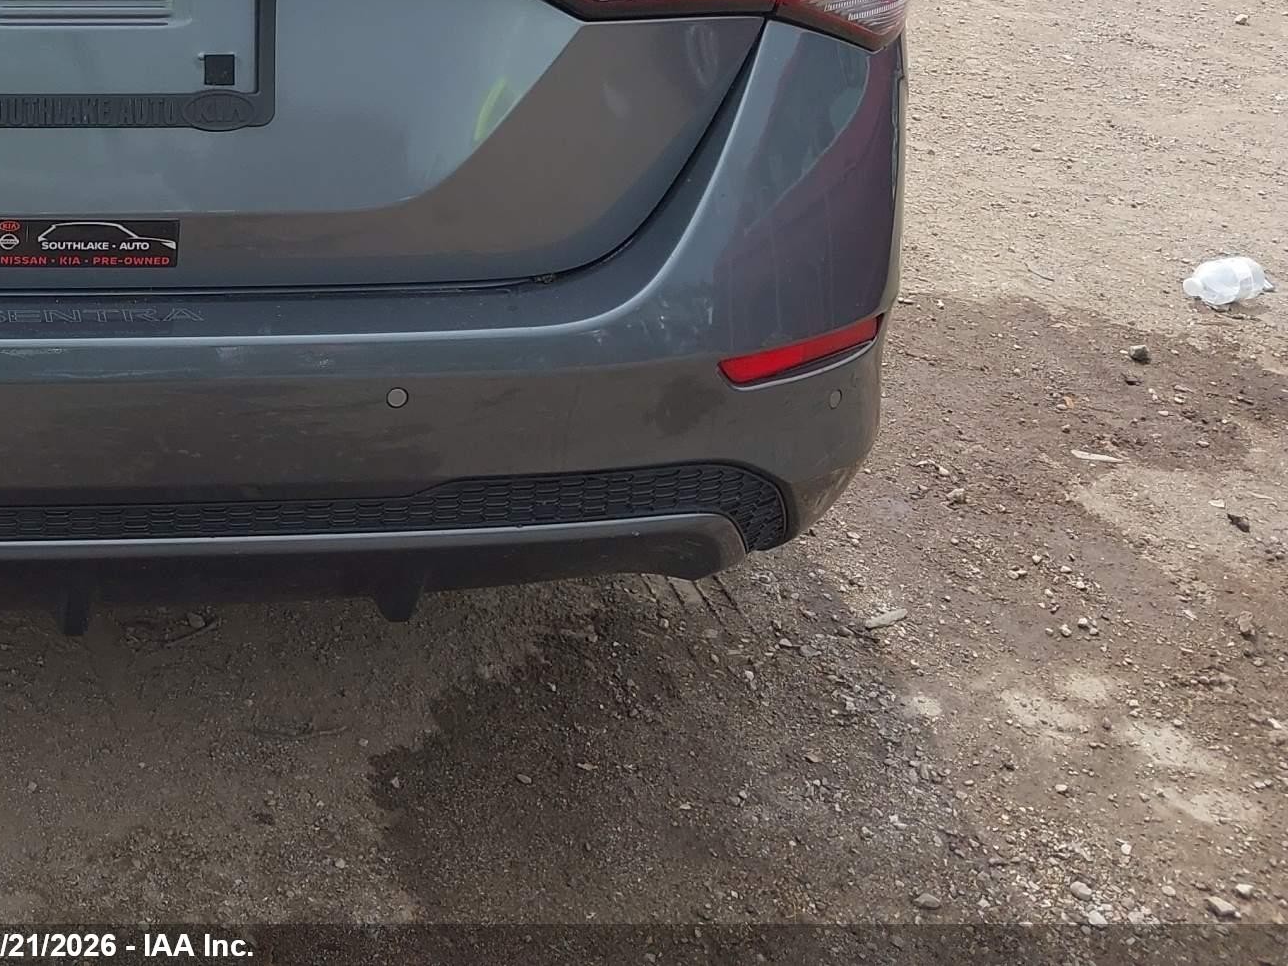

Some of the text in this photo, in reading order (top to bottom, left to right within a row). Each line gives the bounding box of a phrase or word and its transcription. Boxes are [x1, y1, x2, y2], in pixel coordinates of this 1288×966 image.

[118, 97, 178, 126] AUTO
[2, 222, 17, 230] KIA
[41, 241, 150, 251] SOUTHLAKE AUTO
[0, 256, 170, 266] NISSAN KIA PRE-OWNED
